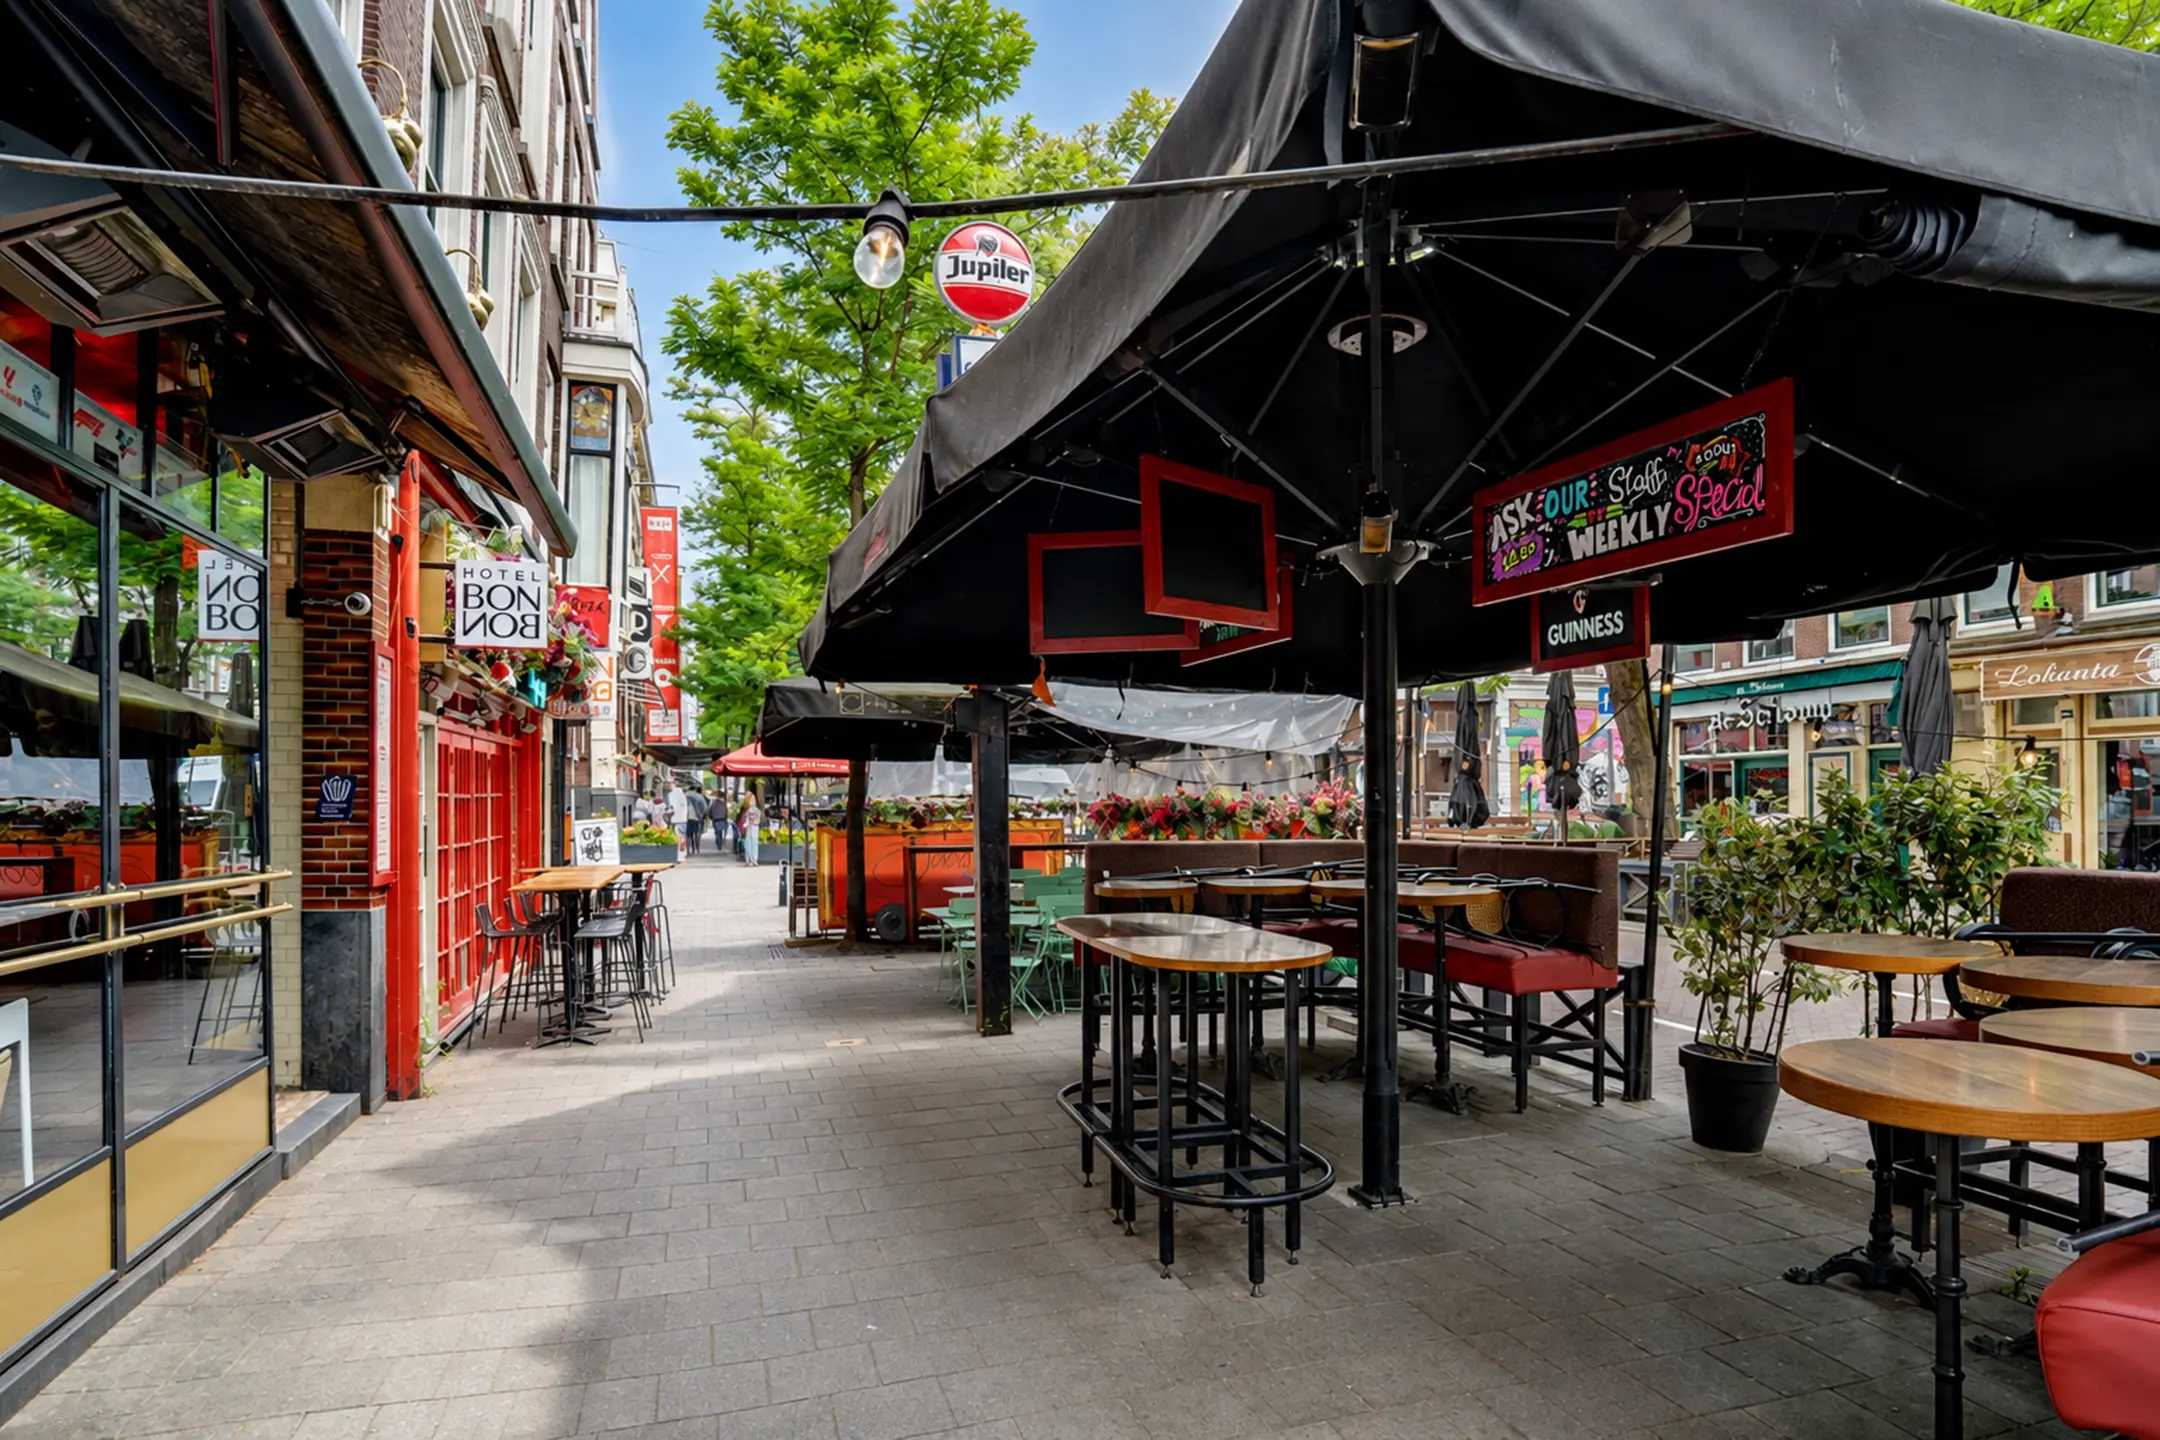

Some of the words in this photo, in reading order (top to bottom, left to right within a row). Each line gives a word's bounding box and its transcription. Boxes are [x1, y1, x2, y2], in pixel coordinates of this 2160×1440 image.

[946, 255, 1030, 284] Jupiler
[1491, 492, 1535, 552] ASK
[1544, 480, 1589, 518] OUR
[1567, 502, 1672, 561] WEEKLY
[462, 567, 541, 582] HOTEL
[462, 584, 541, 612] BON
[206, 604, 259, 631] BO
[1547, 611, 1624, 647] GUINNESS
[1995, 661, 2120, 687] Lokanta
